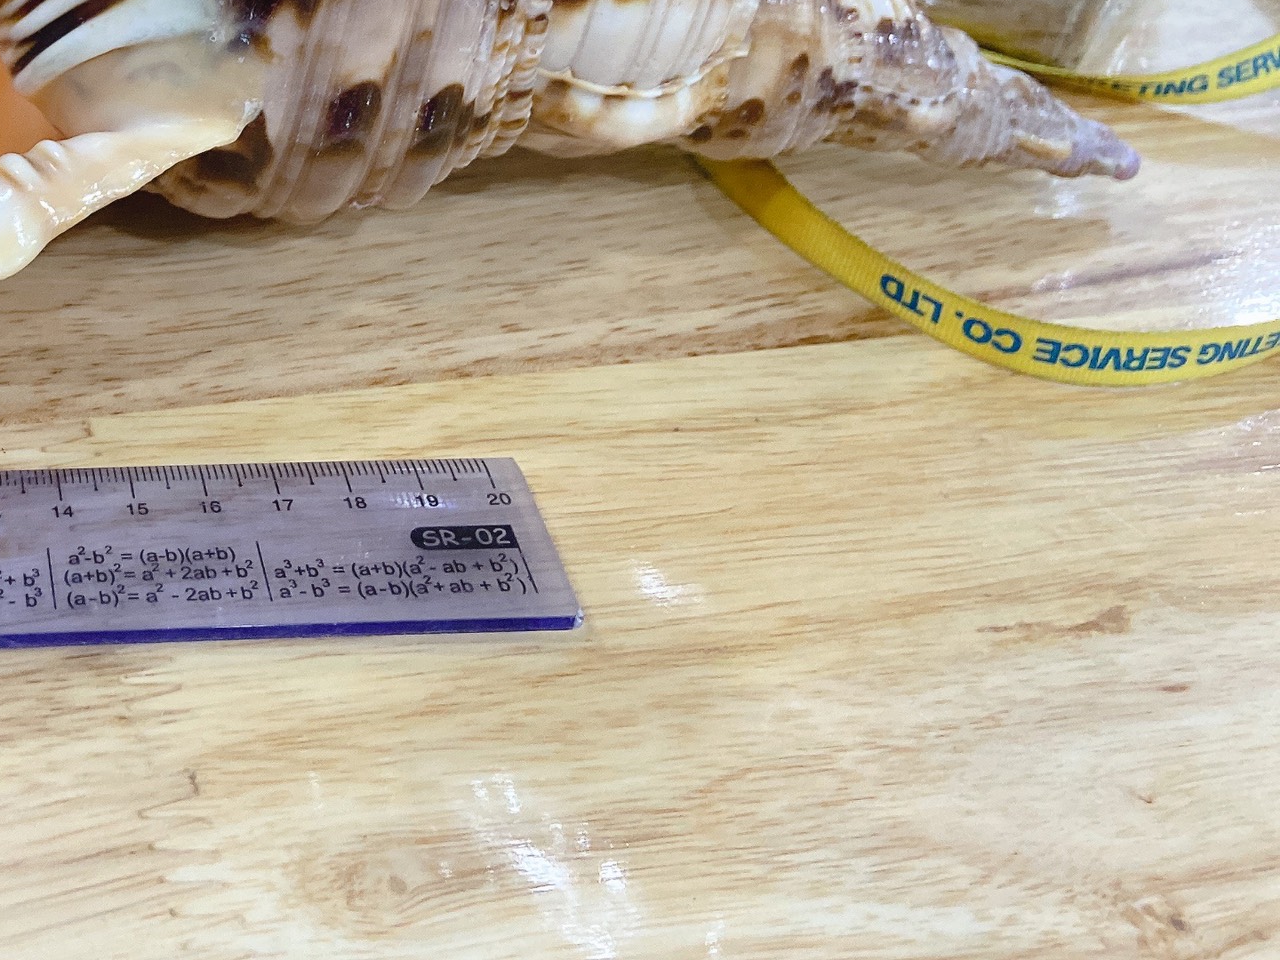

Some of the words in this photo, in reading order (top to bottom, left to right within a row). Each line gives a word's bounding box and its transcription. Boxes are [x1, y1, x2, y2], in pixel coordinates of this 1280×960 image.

[880, 274, 943, 324] LTD
[955, 311, 1023, 354] CO.
[1033, 337, 1191, 371] SERVICE
[52, 505, 74, 518] 14
[127, 503, 149, 515] 15
[199, 501, 222, 513] 16
[272, 499, 294, 511] 17
[344, 497, 367, 509] 18
[415, 494, 439, 507] 19
[487, 493, 511, 505] 20
[423, 527, 511, 547] SR-02
